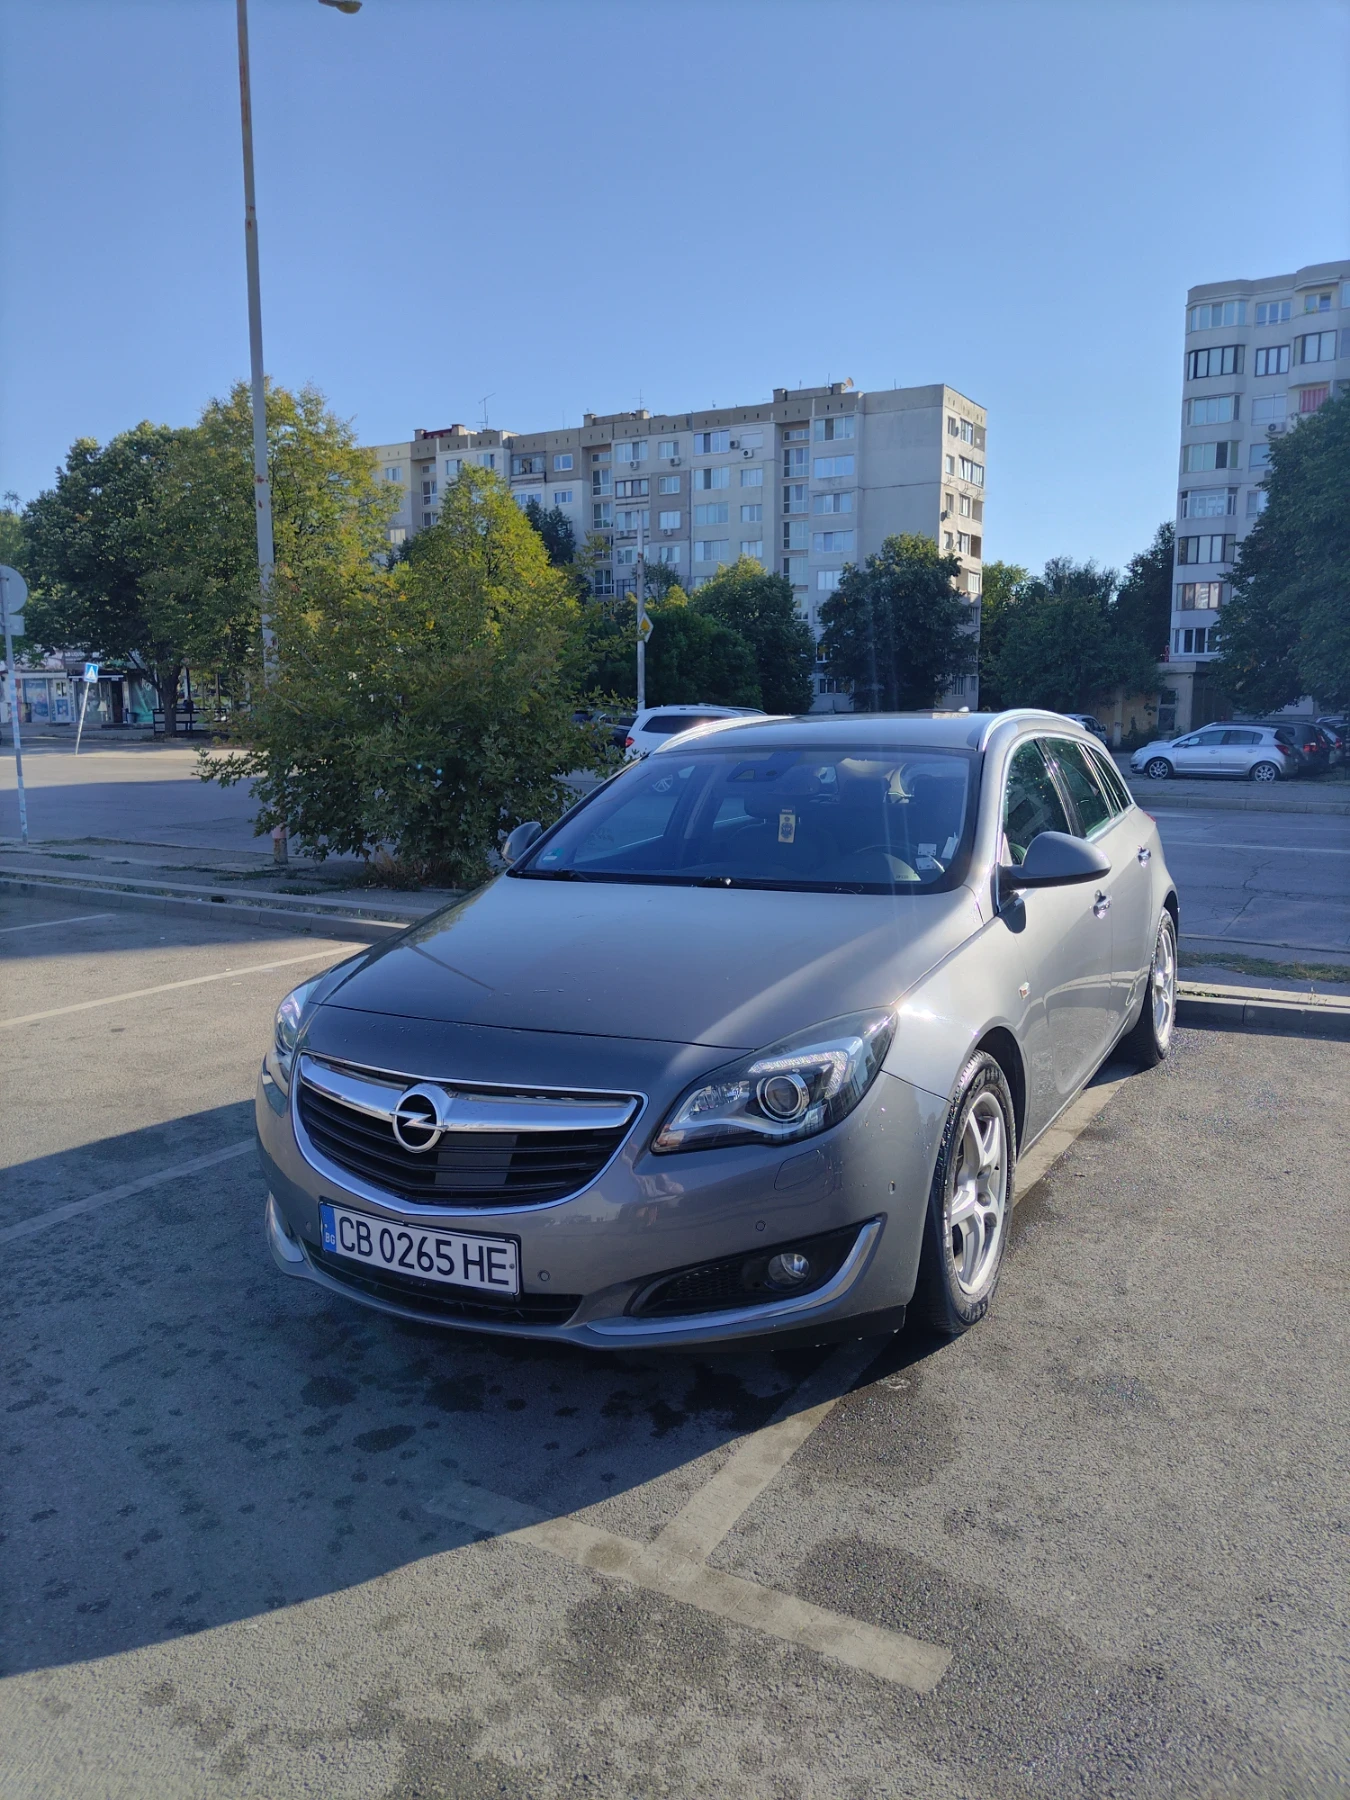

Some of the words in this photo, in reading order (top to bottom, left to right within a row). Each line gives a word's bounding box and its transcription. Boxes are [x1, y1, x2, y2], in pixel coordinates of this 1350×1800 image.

[325, 1232, 336, 1245] BG
[339, 1216, 374, 1257] CB
[379, 1227, 455, 1276] 0265
[462, 1243, 510, 1286] HE
